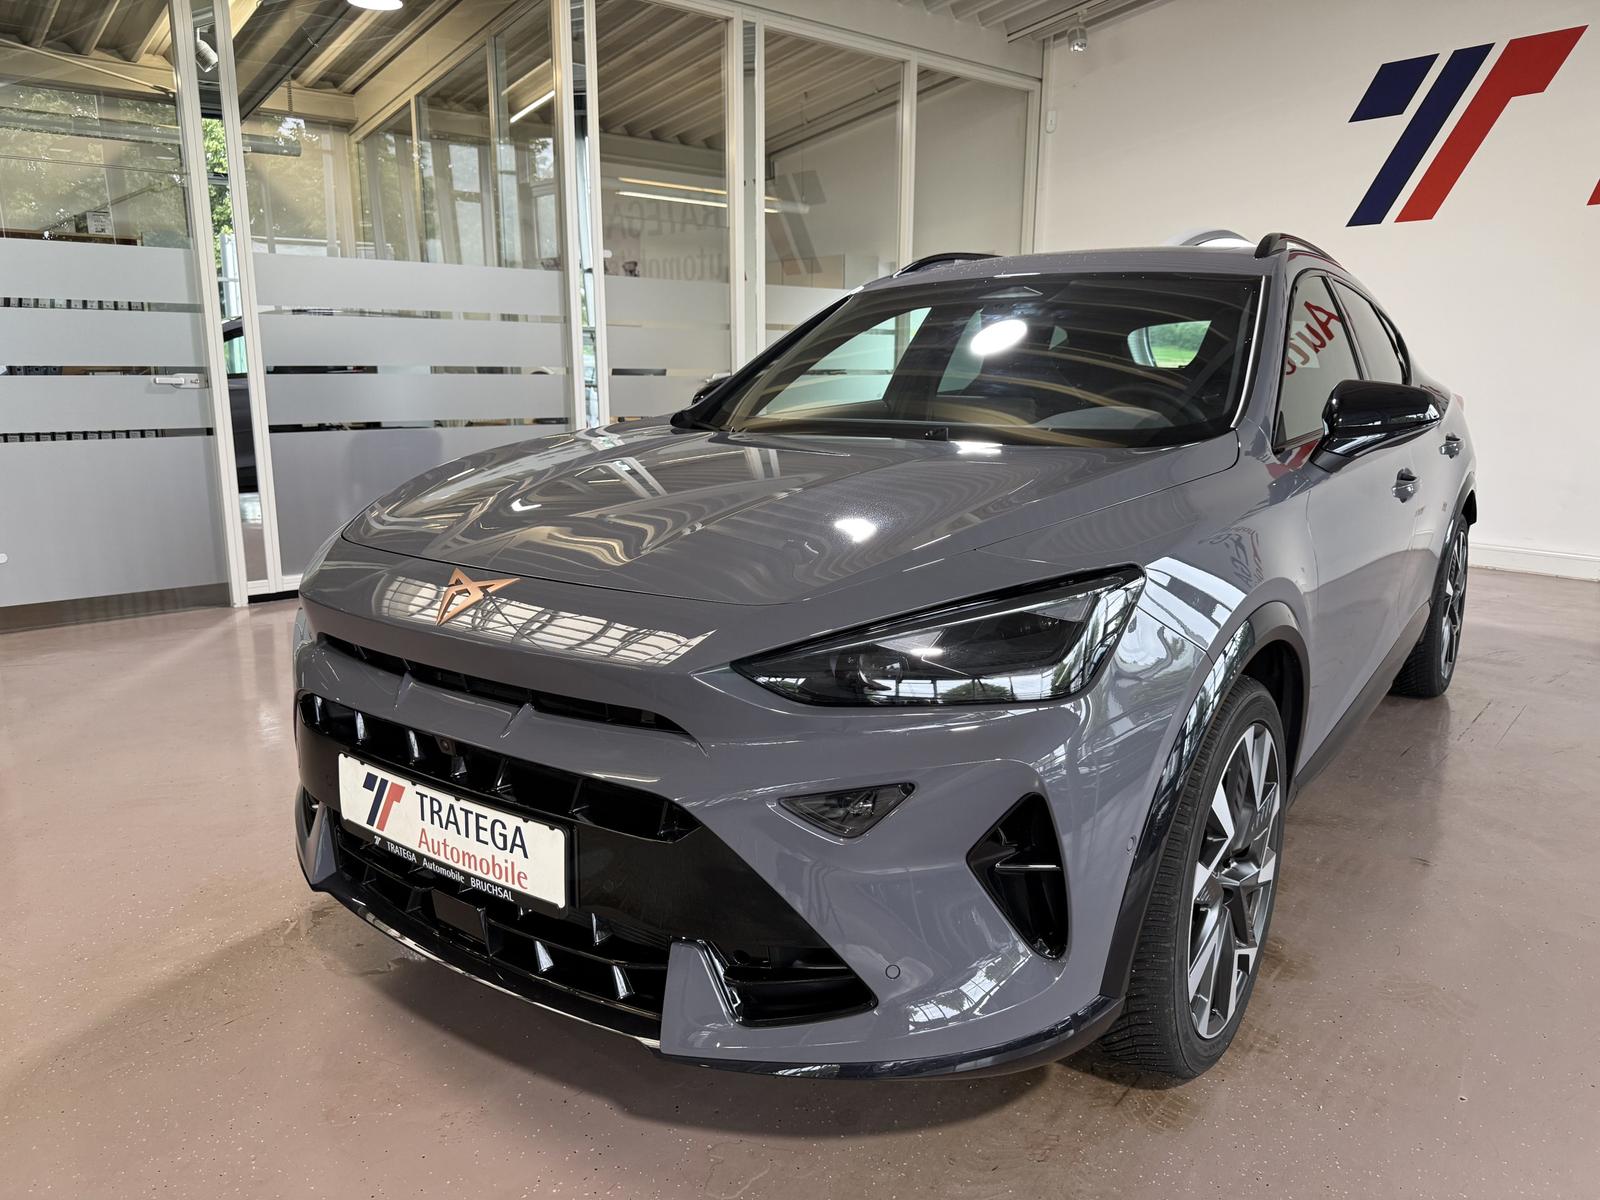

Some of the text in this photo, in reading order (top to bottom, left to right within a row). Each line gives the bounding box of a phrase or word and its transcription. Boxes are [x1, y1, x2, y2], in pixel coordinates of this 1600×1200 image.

[416, 791, 529, 859] TRATEGA
[386, 841, 514, 902] TRATEGA Automobile BRUCHSAL
[418, 827, 529, 890] Automobile
